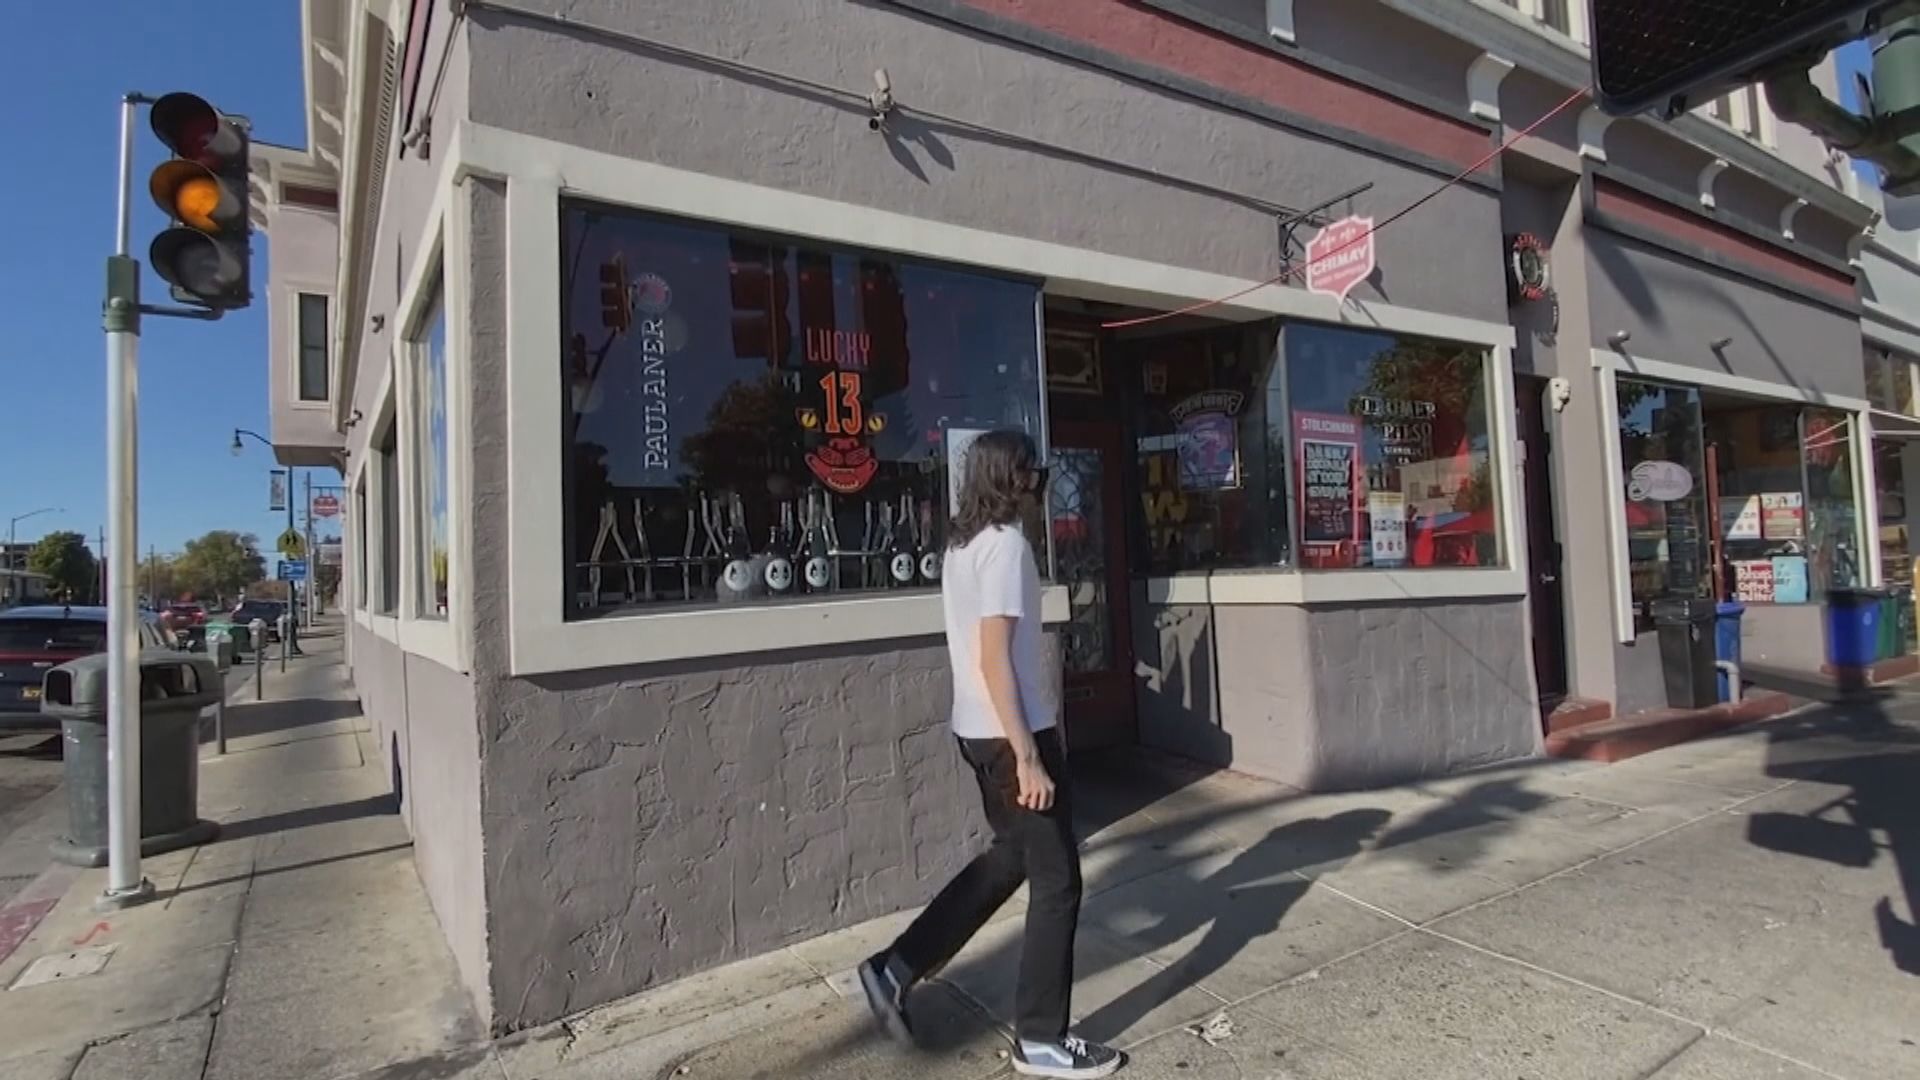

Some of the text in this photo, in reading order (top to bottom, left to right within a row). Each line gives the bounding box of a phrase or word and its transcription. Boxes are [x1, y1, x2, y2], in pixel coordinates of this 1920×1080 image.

[1311, 245, 1368, 275] CHIMAY
[806, 328, 871, 367] LUCKY
[642, 318, 668, 470] PAULANER
[820, 370, 862, 436] 13
